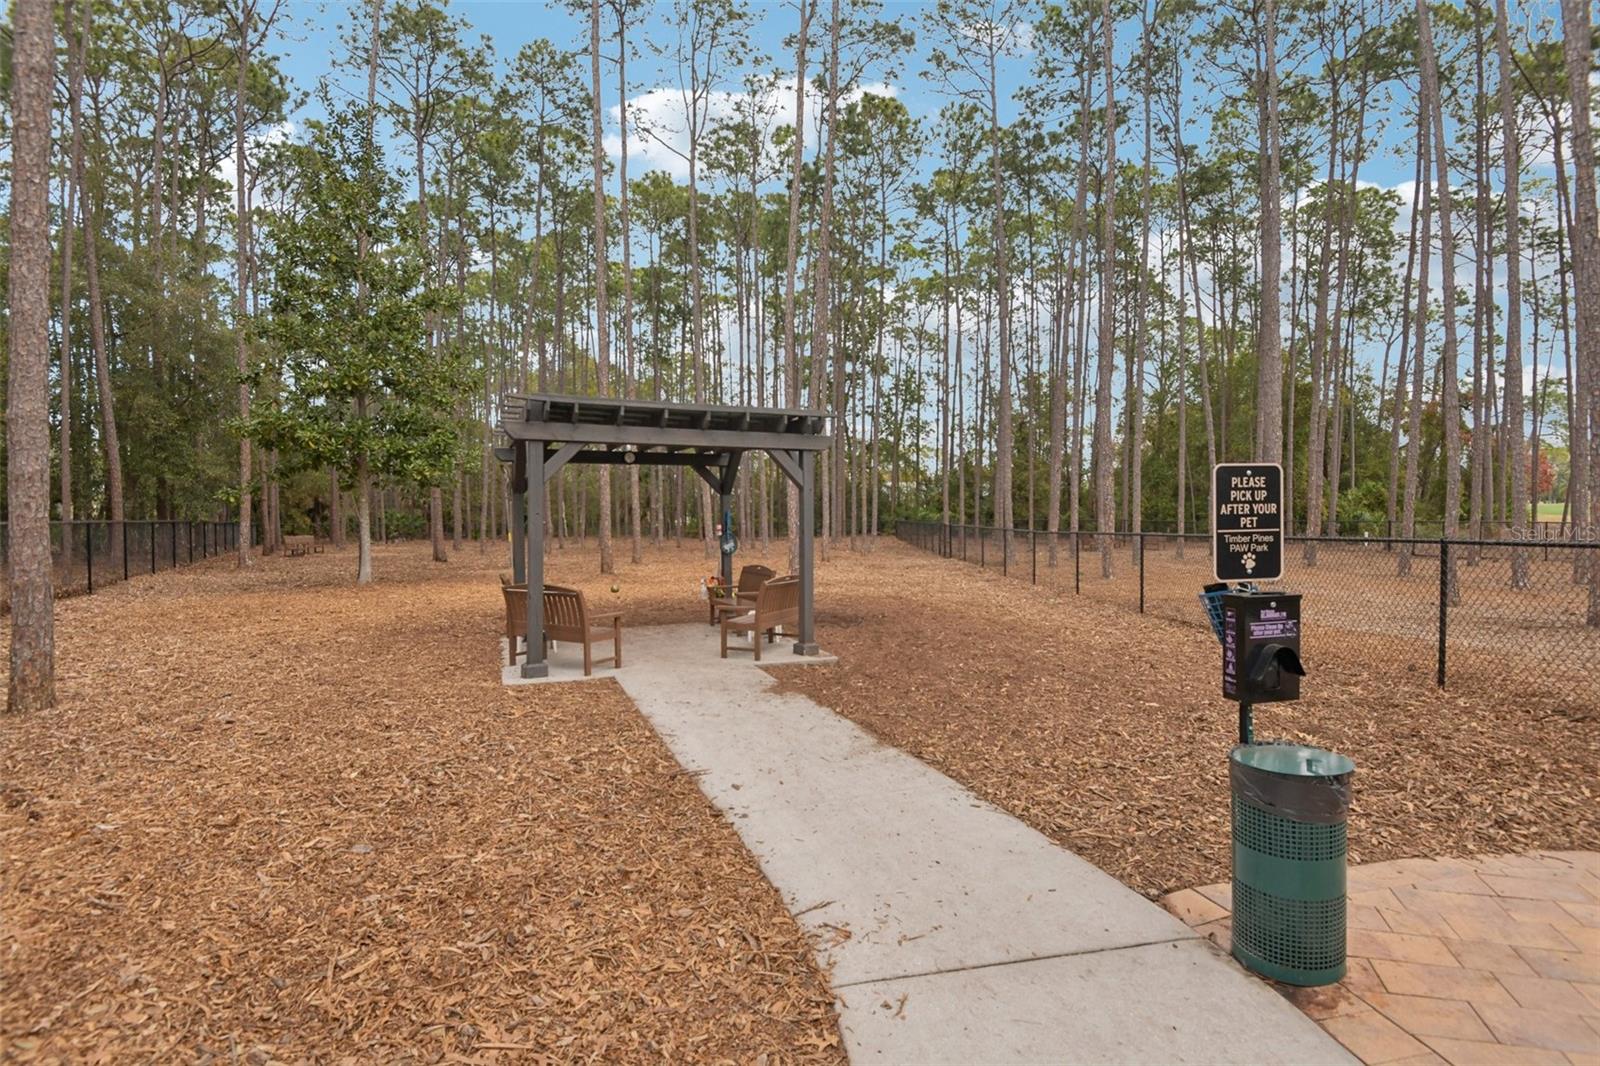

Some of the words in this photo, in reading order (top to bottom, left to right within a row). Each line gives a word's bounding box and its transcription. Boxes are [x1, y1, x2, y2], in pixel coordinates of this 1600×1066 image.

[1231, 476, 1266, 488] PLEASE
[1230, 490, 1252, 501] PICK
[1254, 490, 1267, 501] UP
[1220, 504, 1250, 515] AFTER
[1252, 503, 1277, 514] YOUR
[1240, 517, 1258, 528] PET
[1224, 534, 1251, 543] Timber
[1252, 533, 1274, 543] Pines
[1229, 544, 1249, 552] PAW
[1250, 543, 1268, 552] Park
